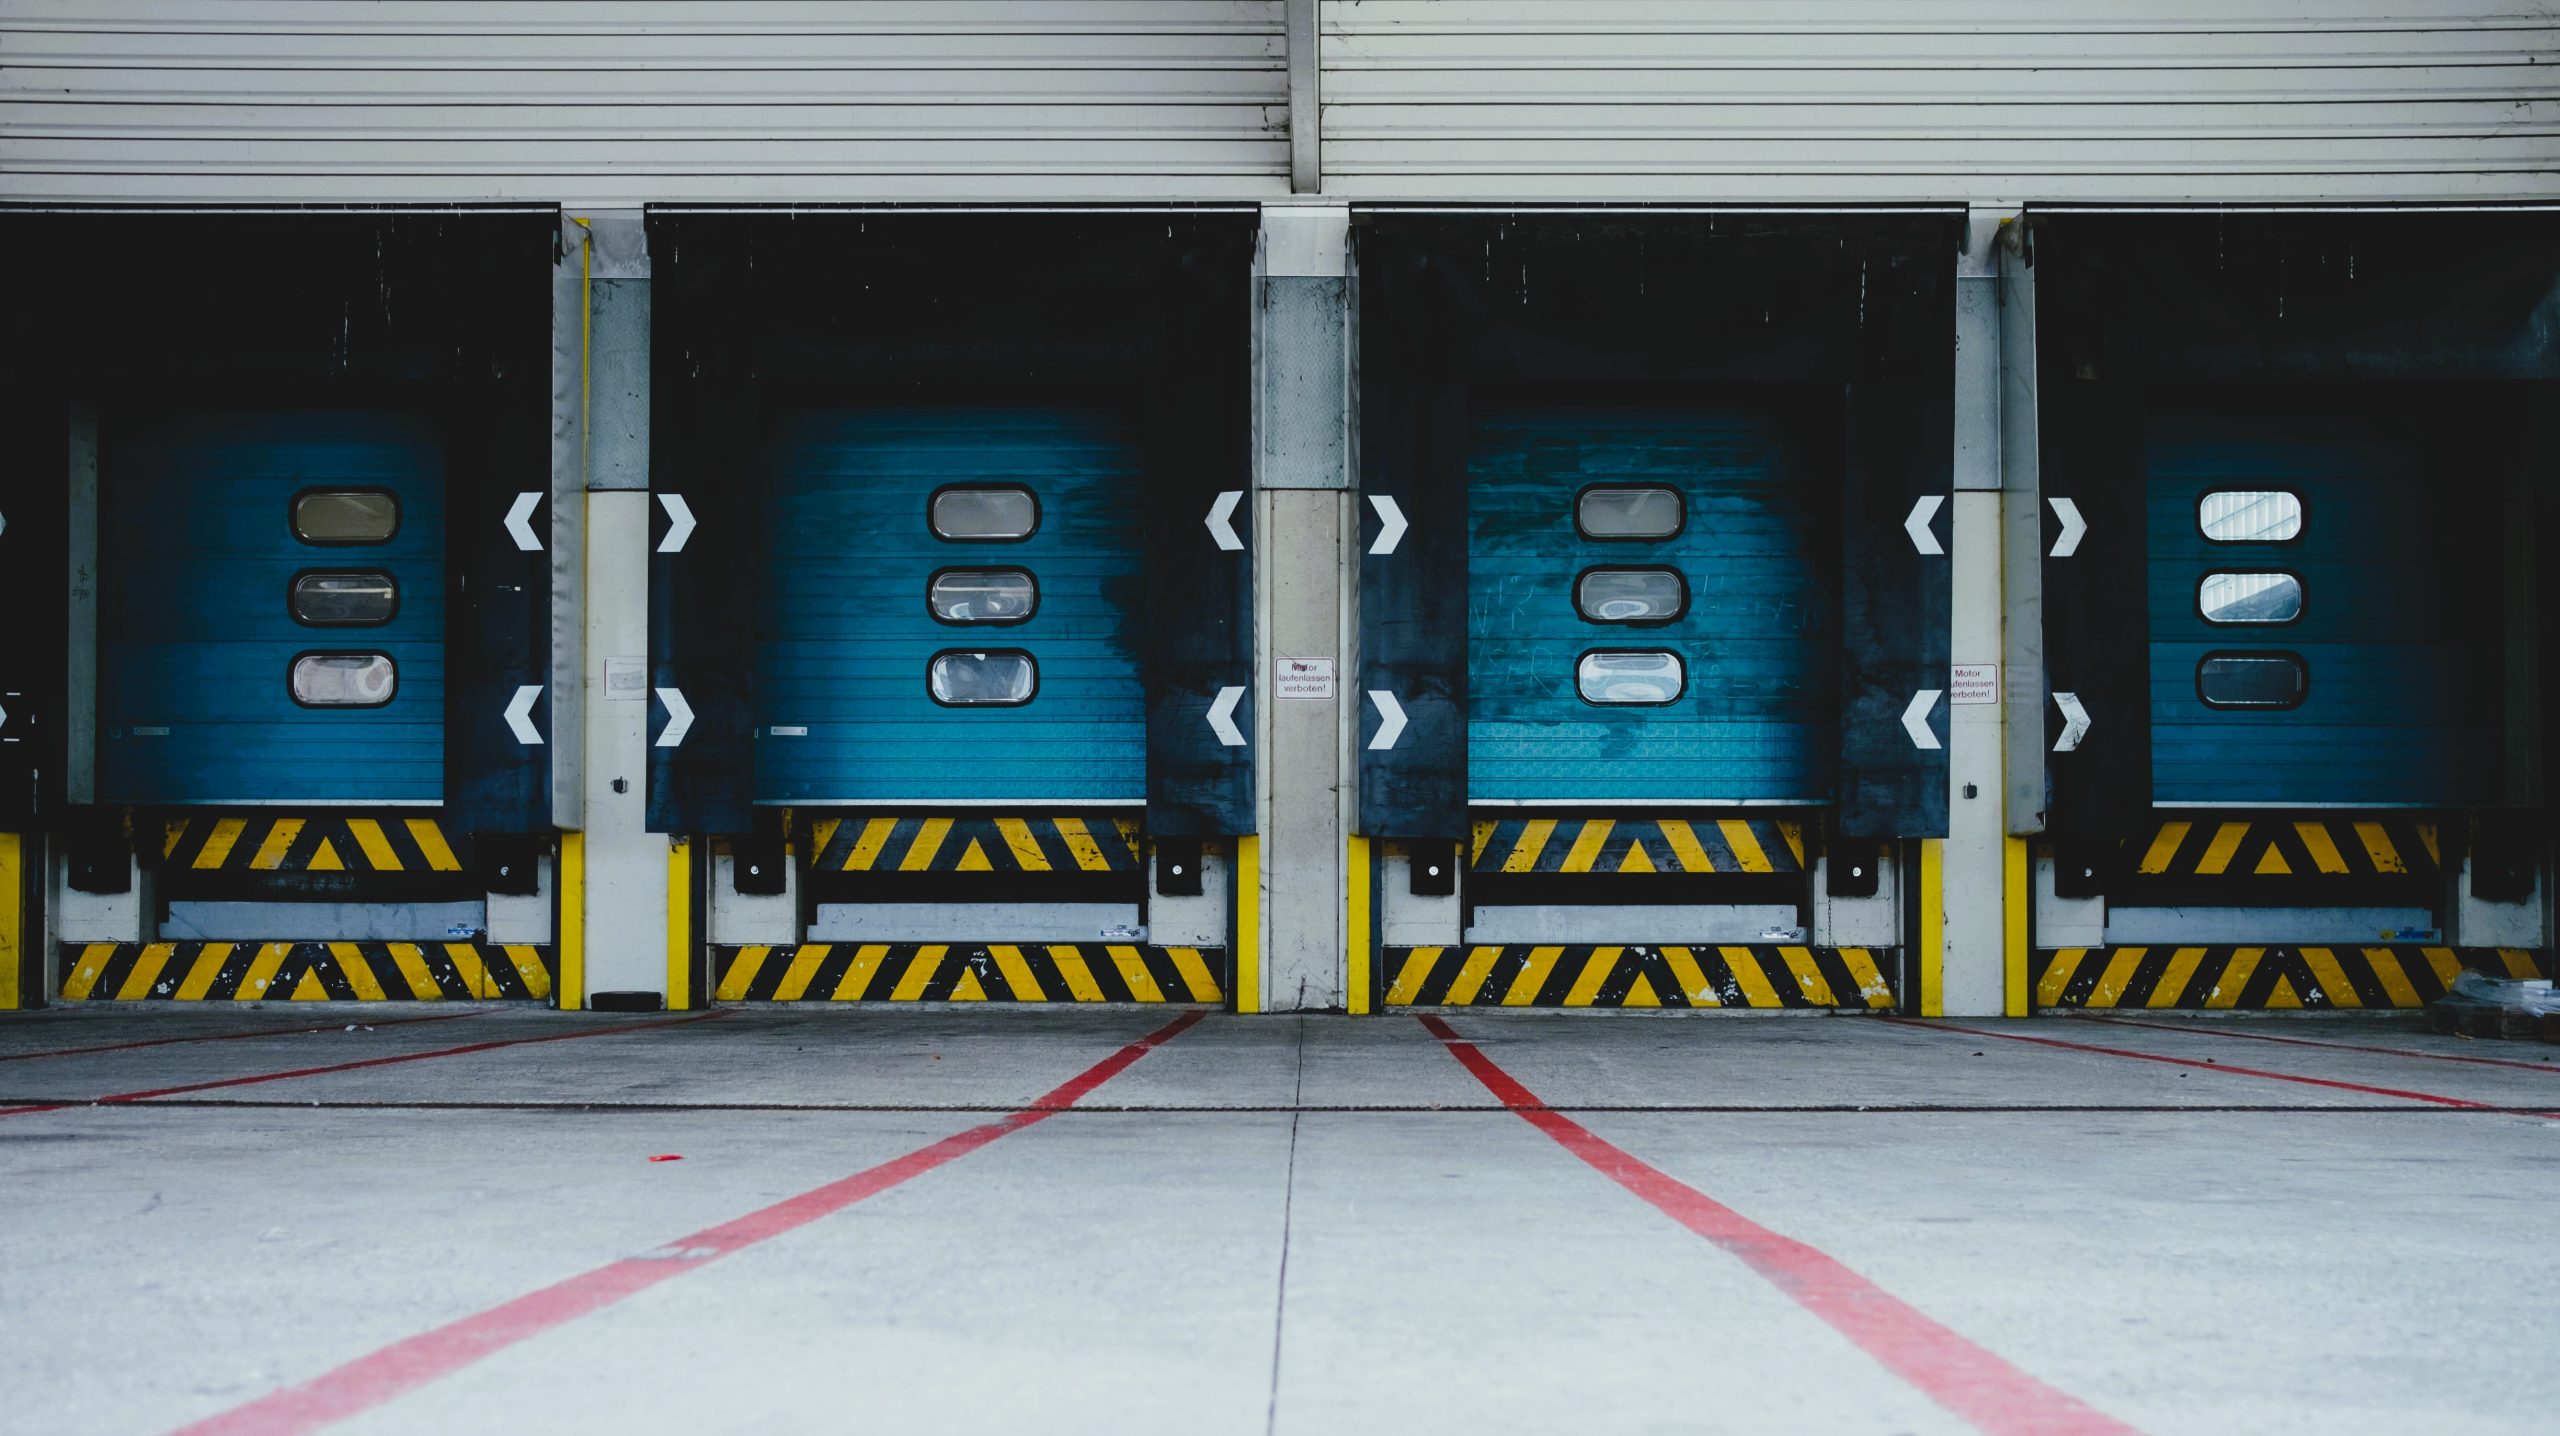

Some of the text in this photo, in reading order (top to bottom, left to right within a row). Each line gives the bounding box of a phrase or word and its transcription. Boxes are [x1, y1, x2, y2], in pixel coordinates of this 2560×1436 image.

[1955, 669, 1981, 677] Motor
[1278, 673, 1331, 682] laufenlassen
[1284, 684, 1326, 692] verboten!
[1951, 689, 1990, 698] erboten!
